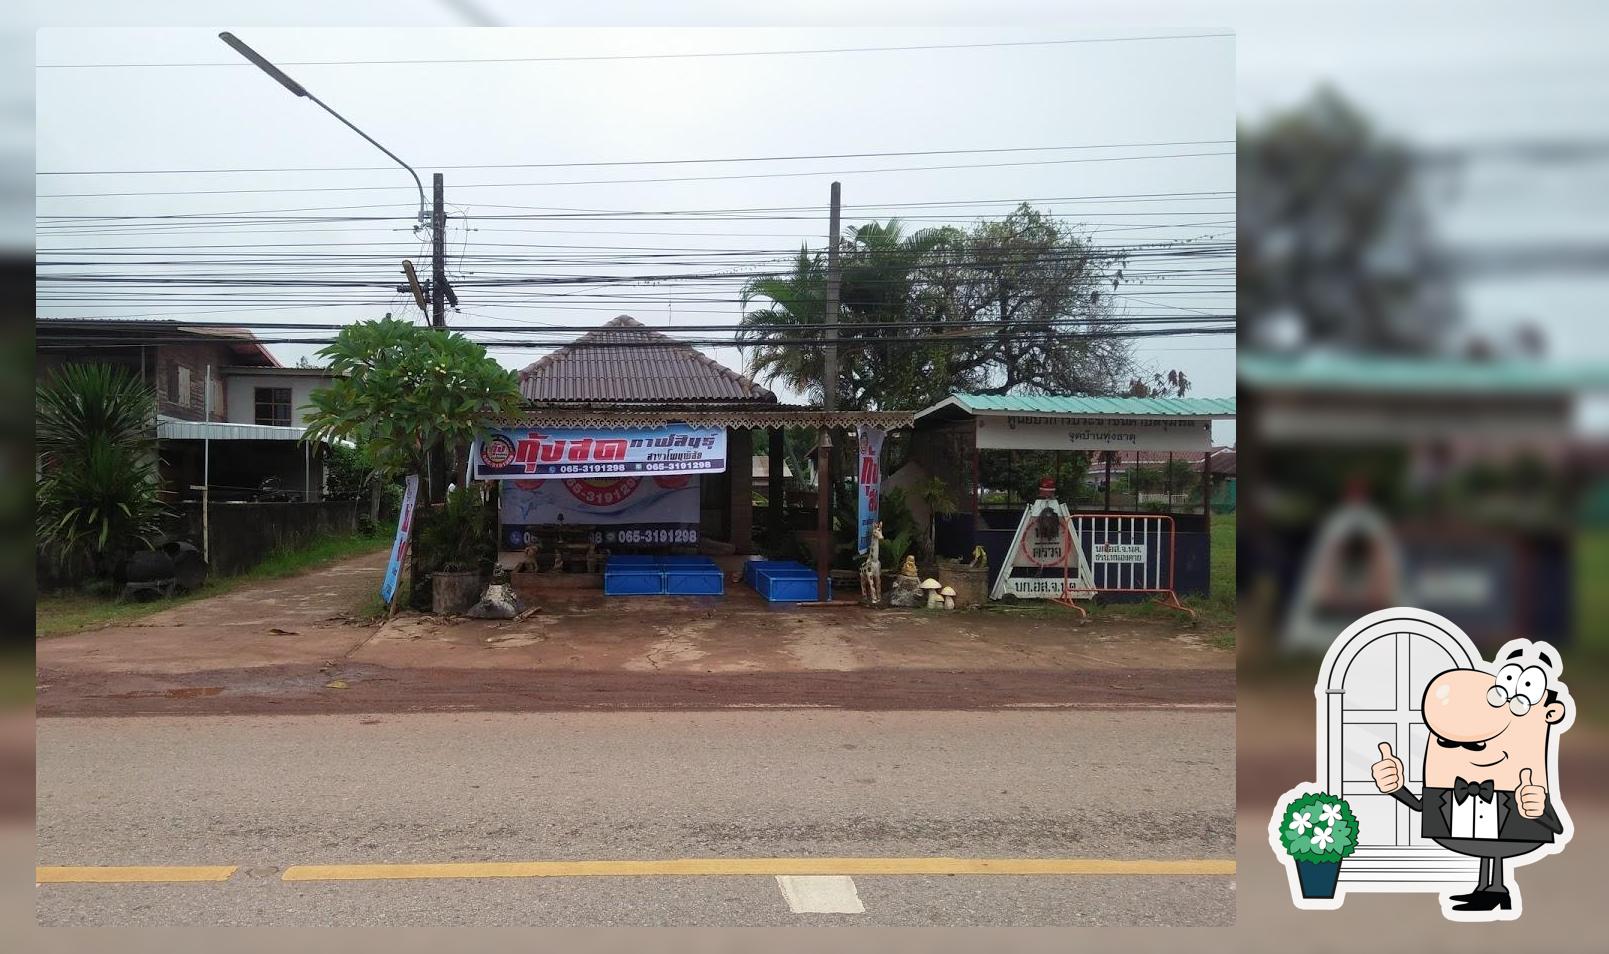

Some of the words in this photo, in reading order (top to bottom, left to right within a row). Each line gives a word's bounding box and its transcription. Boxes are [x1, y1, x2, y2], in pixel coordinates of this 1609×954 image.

[514, 432, 628, 474] กุ้งสด
[560, 464, 626, 473] 065-3191298
[645, 461, 712, 471] 065-3191298
[618, 530, 698, 545] 065-3191298
